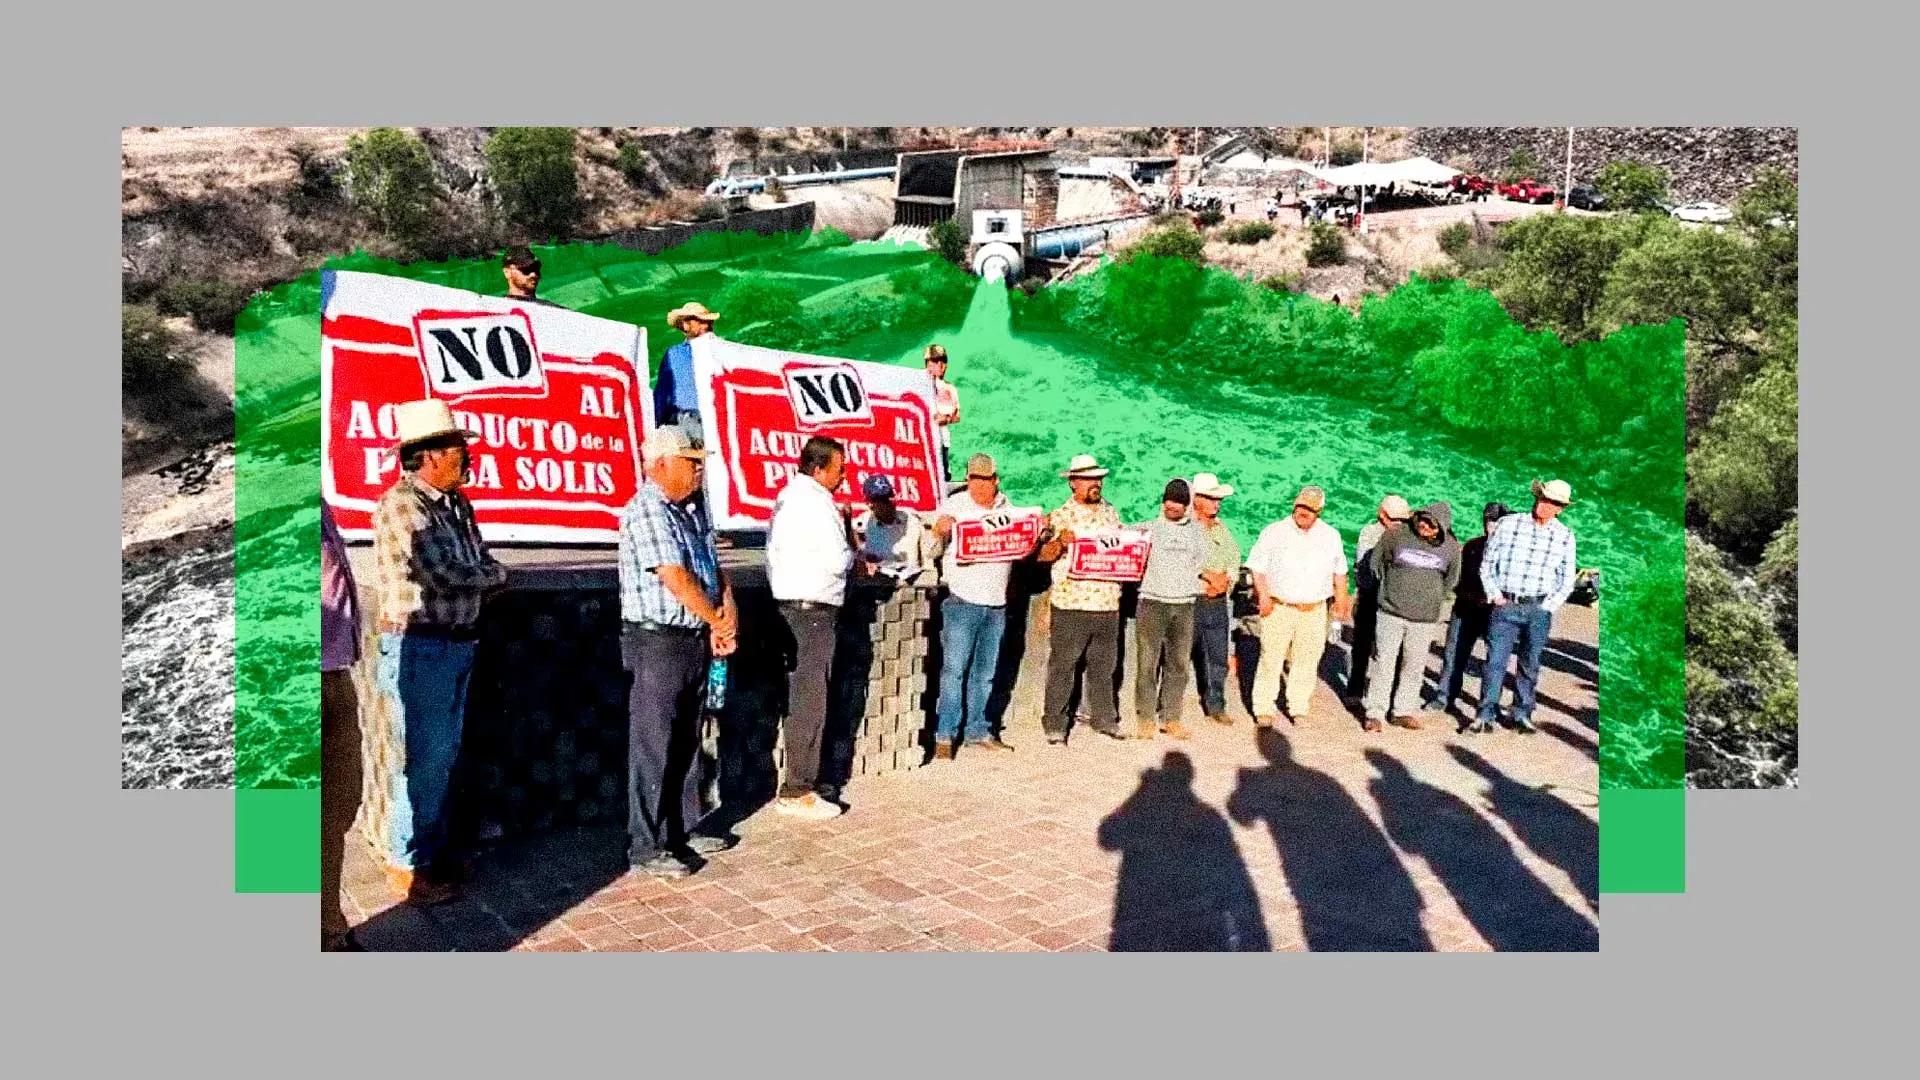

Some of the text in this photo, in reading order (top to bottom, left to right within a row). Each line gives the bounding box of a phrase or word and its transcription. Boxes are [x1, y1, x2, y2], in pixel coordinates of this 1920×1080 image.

[429, 326, 532, 383] NO
[580, 384, 620, 418] AL
[793, 372, 862, 416] NO
[346, 400, 624, 453] ACDUCTO de la
[894, 416, 919, 443] AL
[515, 457, 616, 495] SOLIS
